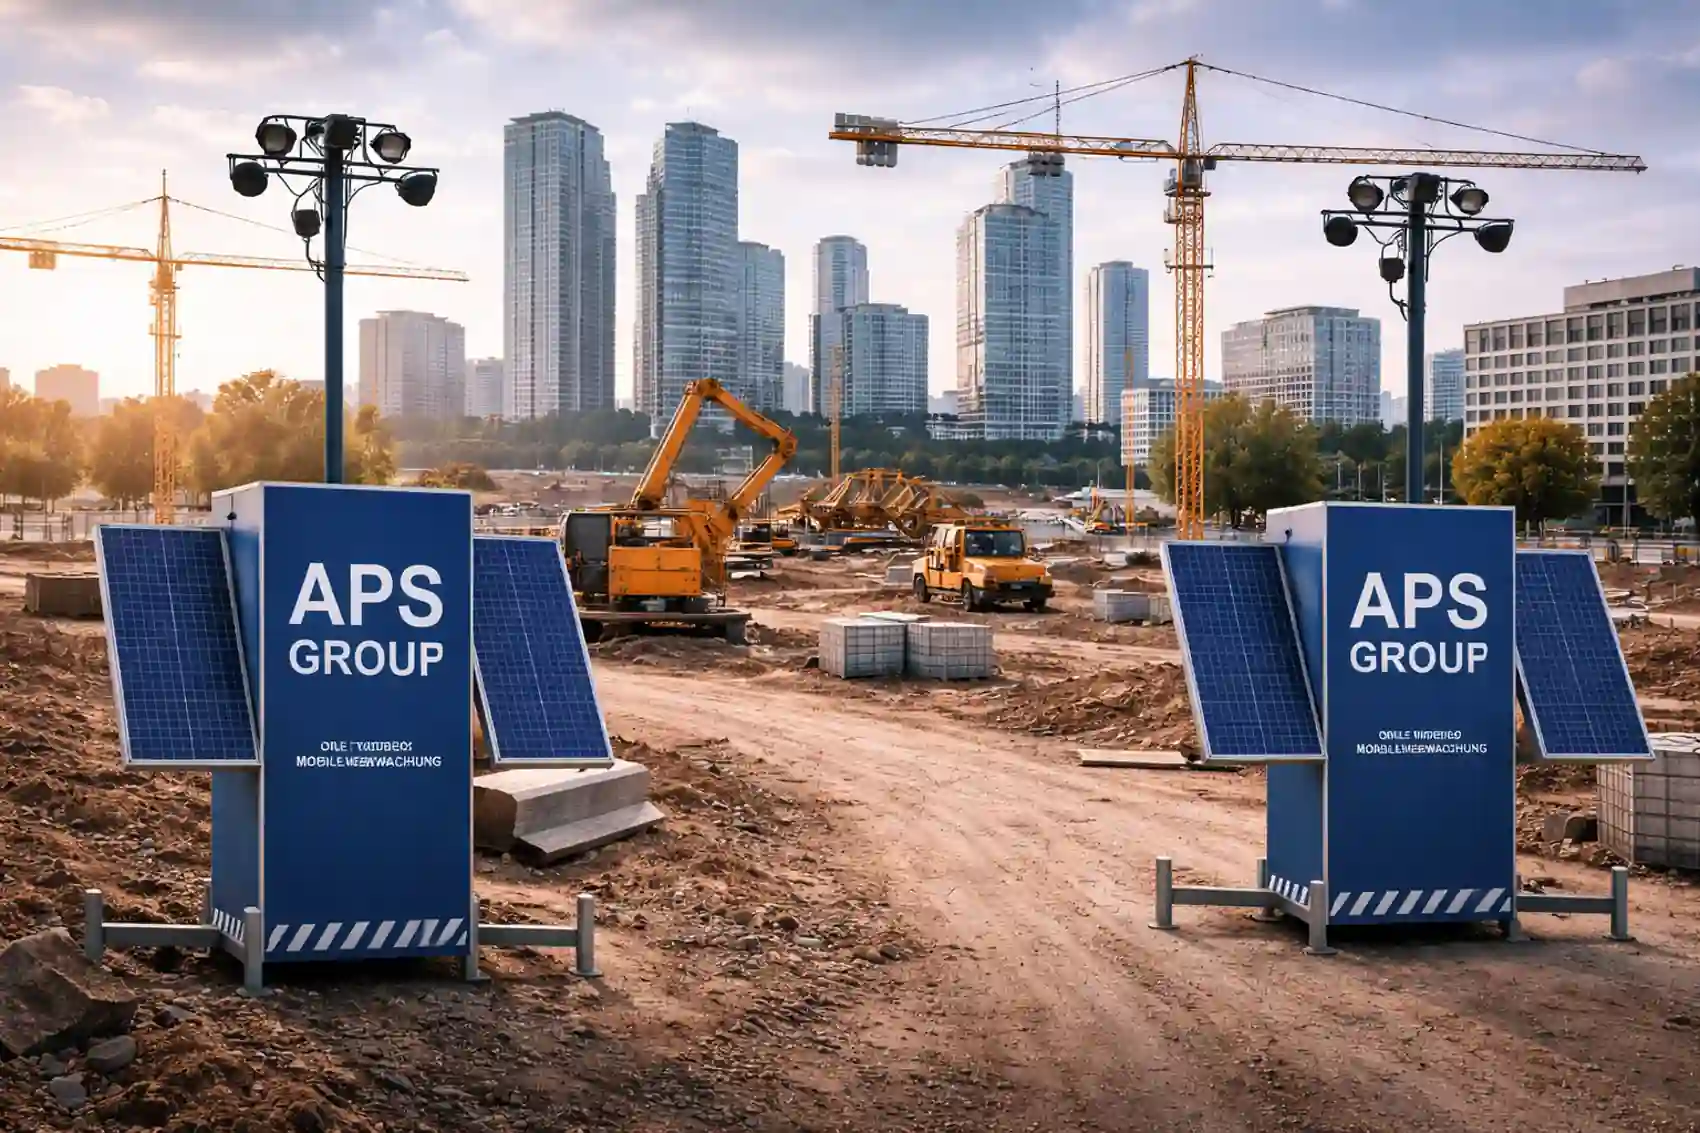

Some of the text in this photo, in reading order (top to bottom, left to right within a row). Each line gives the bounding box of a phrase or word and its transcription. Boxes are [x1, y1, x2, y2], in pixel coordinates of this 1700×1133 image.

[289, 562, 444, 628] APS
[1349, 571, 1488, 630] APS
[289, 638, 444, 677] GROUP
[1349, 640, 1489, 674] GROUP
